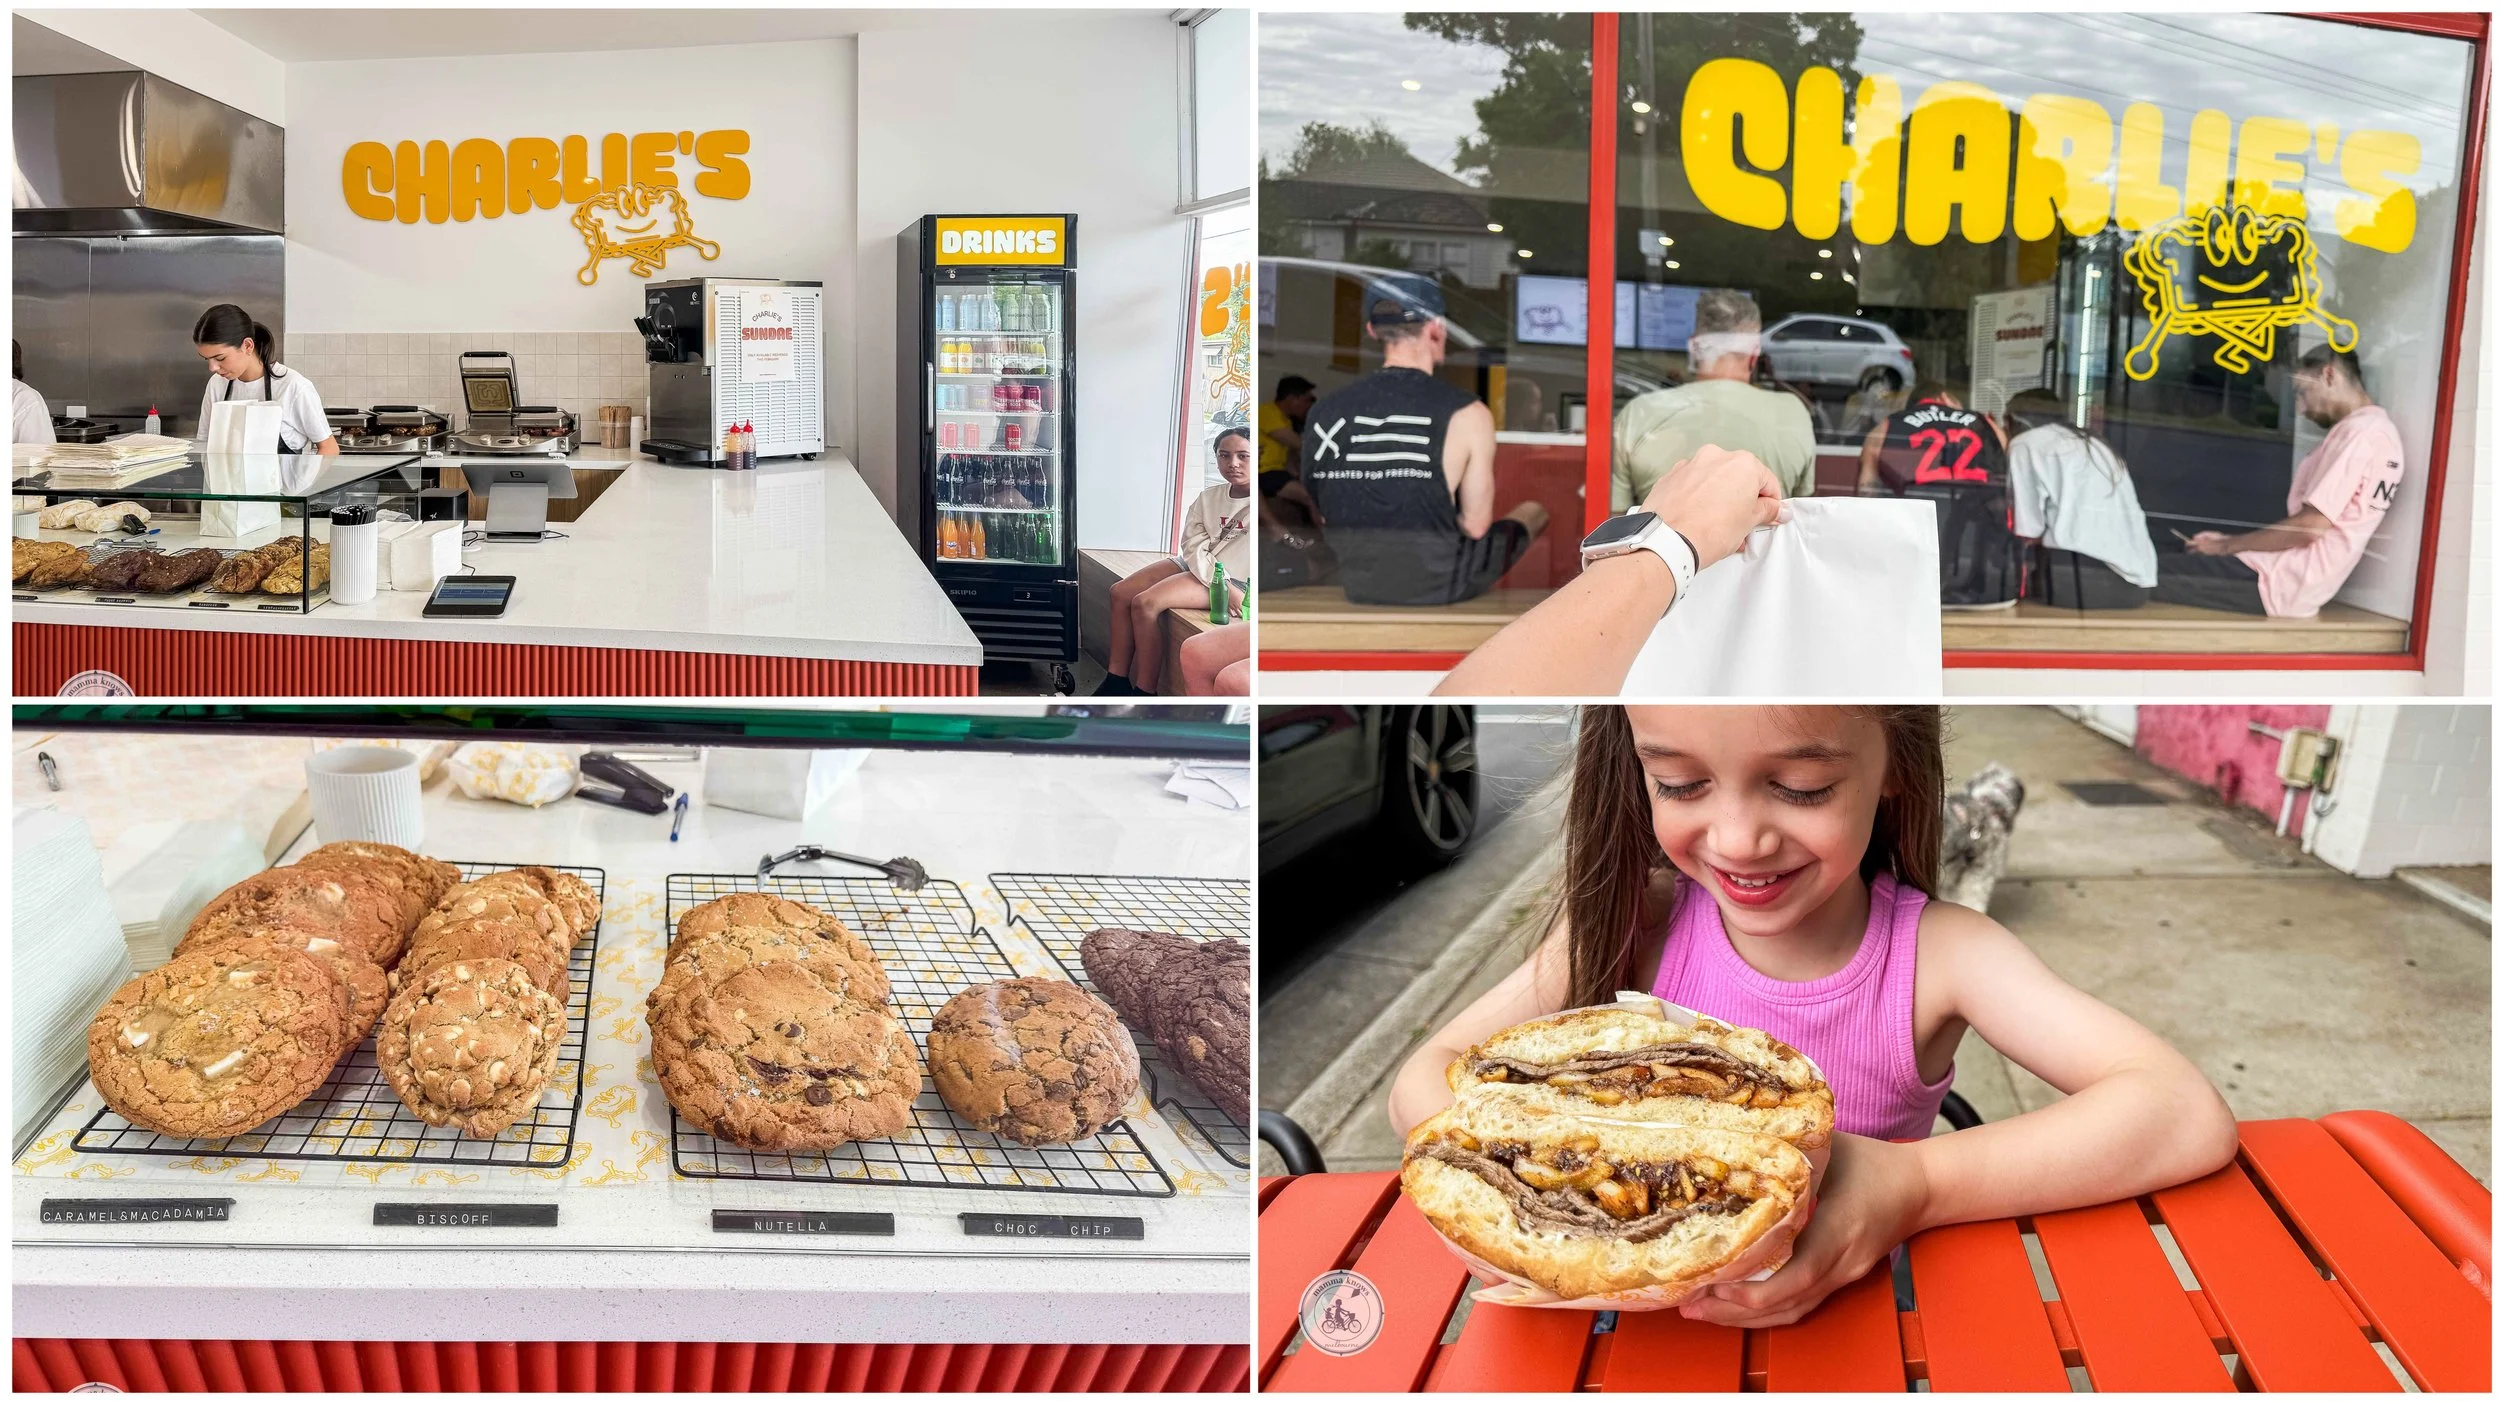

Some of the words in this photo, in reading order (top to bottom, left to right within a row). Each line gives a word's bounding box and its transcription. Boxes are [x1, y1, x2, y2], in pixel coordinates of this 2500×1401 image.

[1681, 57, 2422, 252] CHARLIE'S
[342, 129, 750, 224] CHARLIE'S
[941, 229, 1057, 255] DRINKS
[752, 310, 783, 323] CHARLIE'S
[742, 327, 793, 341] SUNDAE
[1904, 406, 1976, 427] BUTLER
[1909, 428, 1988, 485] 22
[1364, 470, 1384, 481] FOR
[1384, 468, 1433, 480] FREEDOM
[43, 1206, 226, 1222] CARAMEL&MACADAMIA
[417, 1213, 491, 1226] BISCOFF
[754, 1220, 828, 1233] NUTELLA
[994, 1221, 1037, 1235] CHOC
[1070, 1224, 1113, 1237] CHIP
